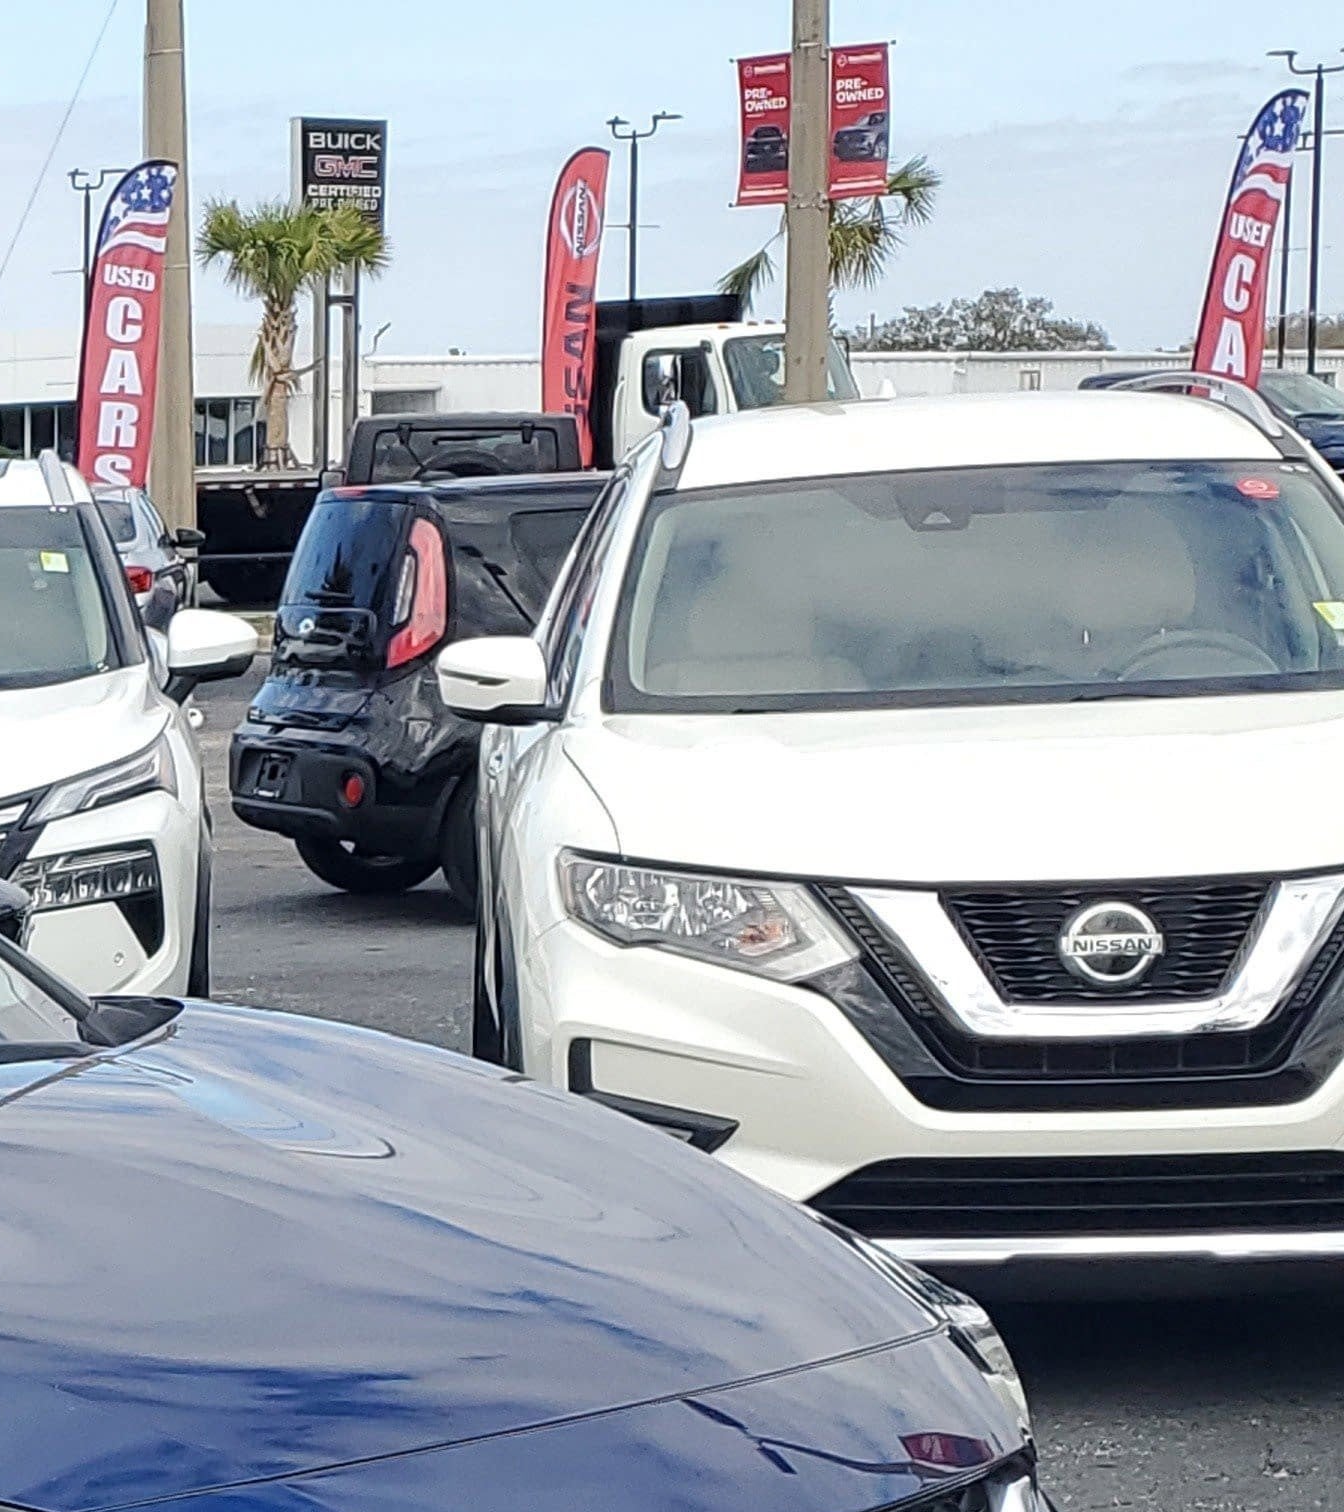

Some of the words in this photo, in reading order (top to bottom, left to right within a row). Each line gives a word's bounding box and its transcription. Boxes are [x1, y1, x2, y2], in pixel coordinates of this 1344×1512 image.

[836, 78, 868, 91] PRE-
[744, 87, 773, 100] PRE-
[836, 88, 885, 103] OWNED
[745, 97, 787, 112] OWNED
[308, 132, 382, 151] BUICK
[314, 154, 378, 178] GMC
[307, 184, 382, 198] CERTIFIED
[576, 186, 588, 256] NISSAN
[103, 263, 156, 292] USED
[1211, 253, 1256, 397] CA
[94, 296, 144, 486] CARS
[1073, 938, 1153, 952] NISSAN
